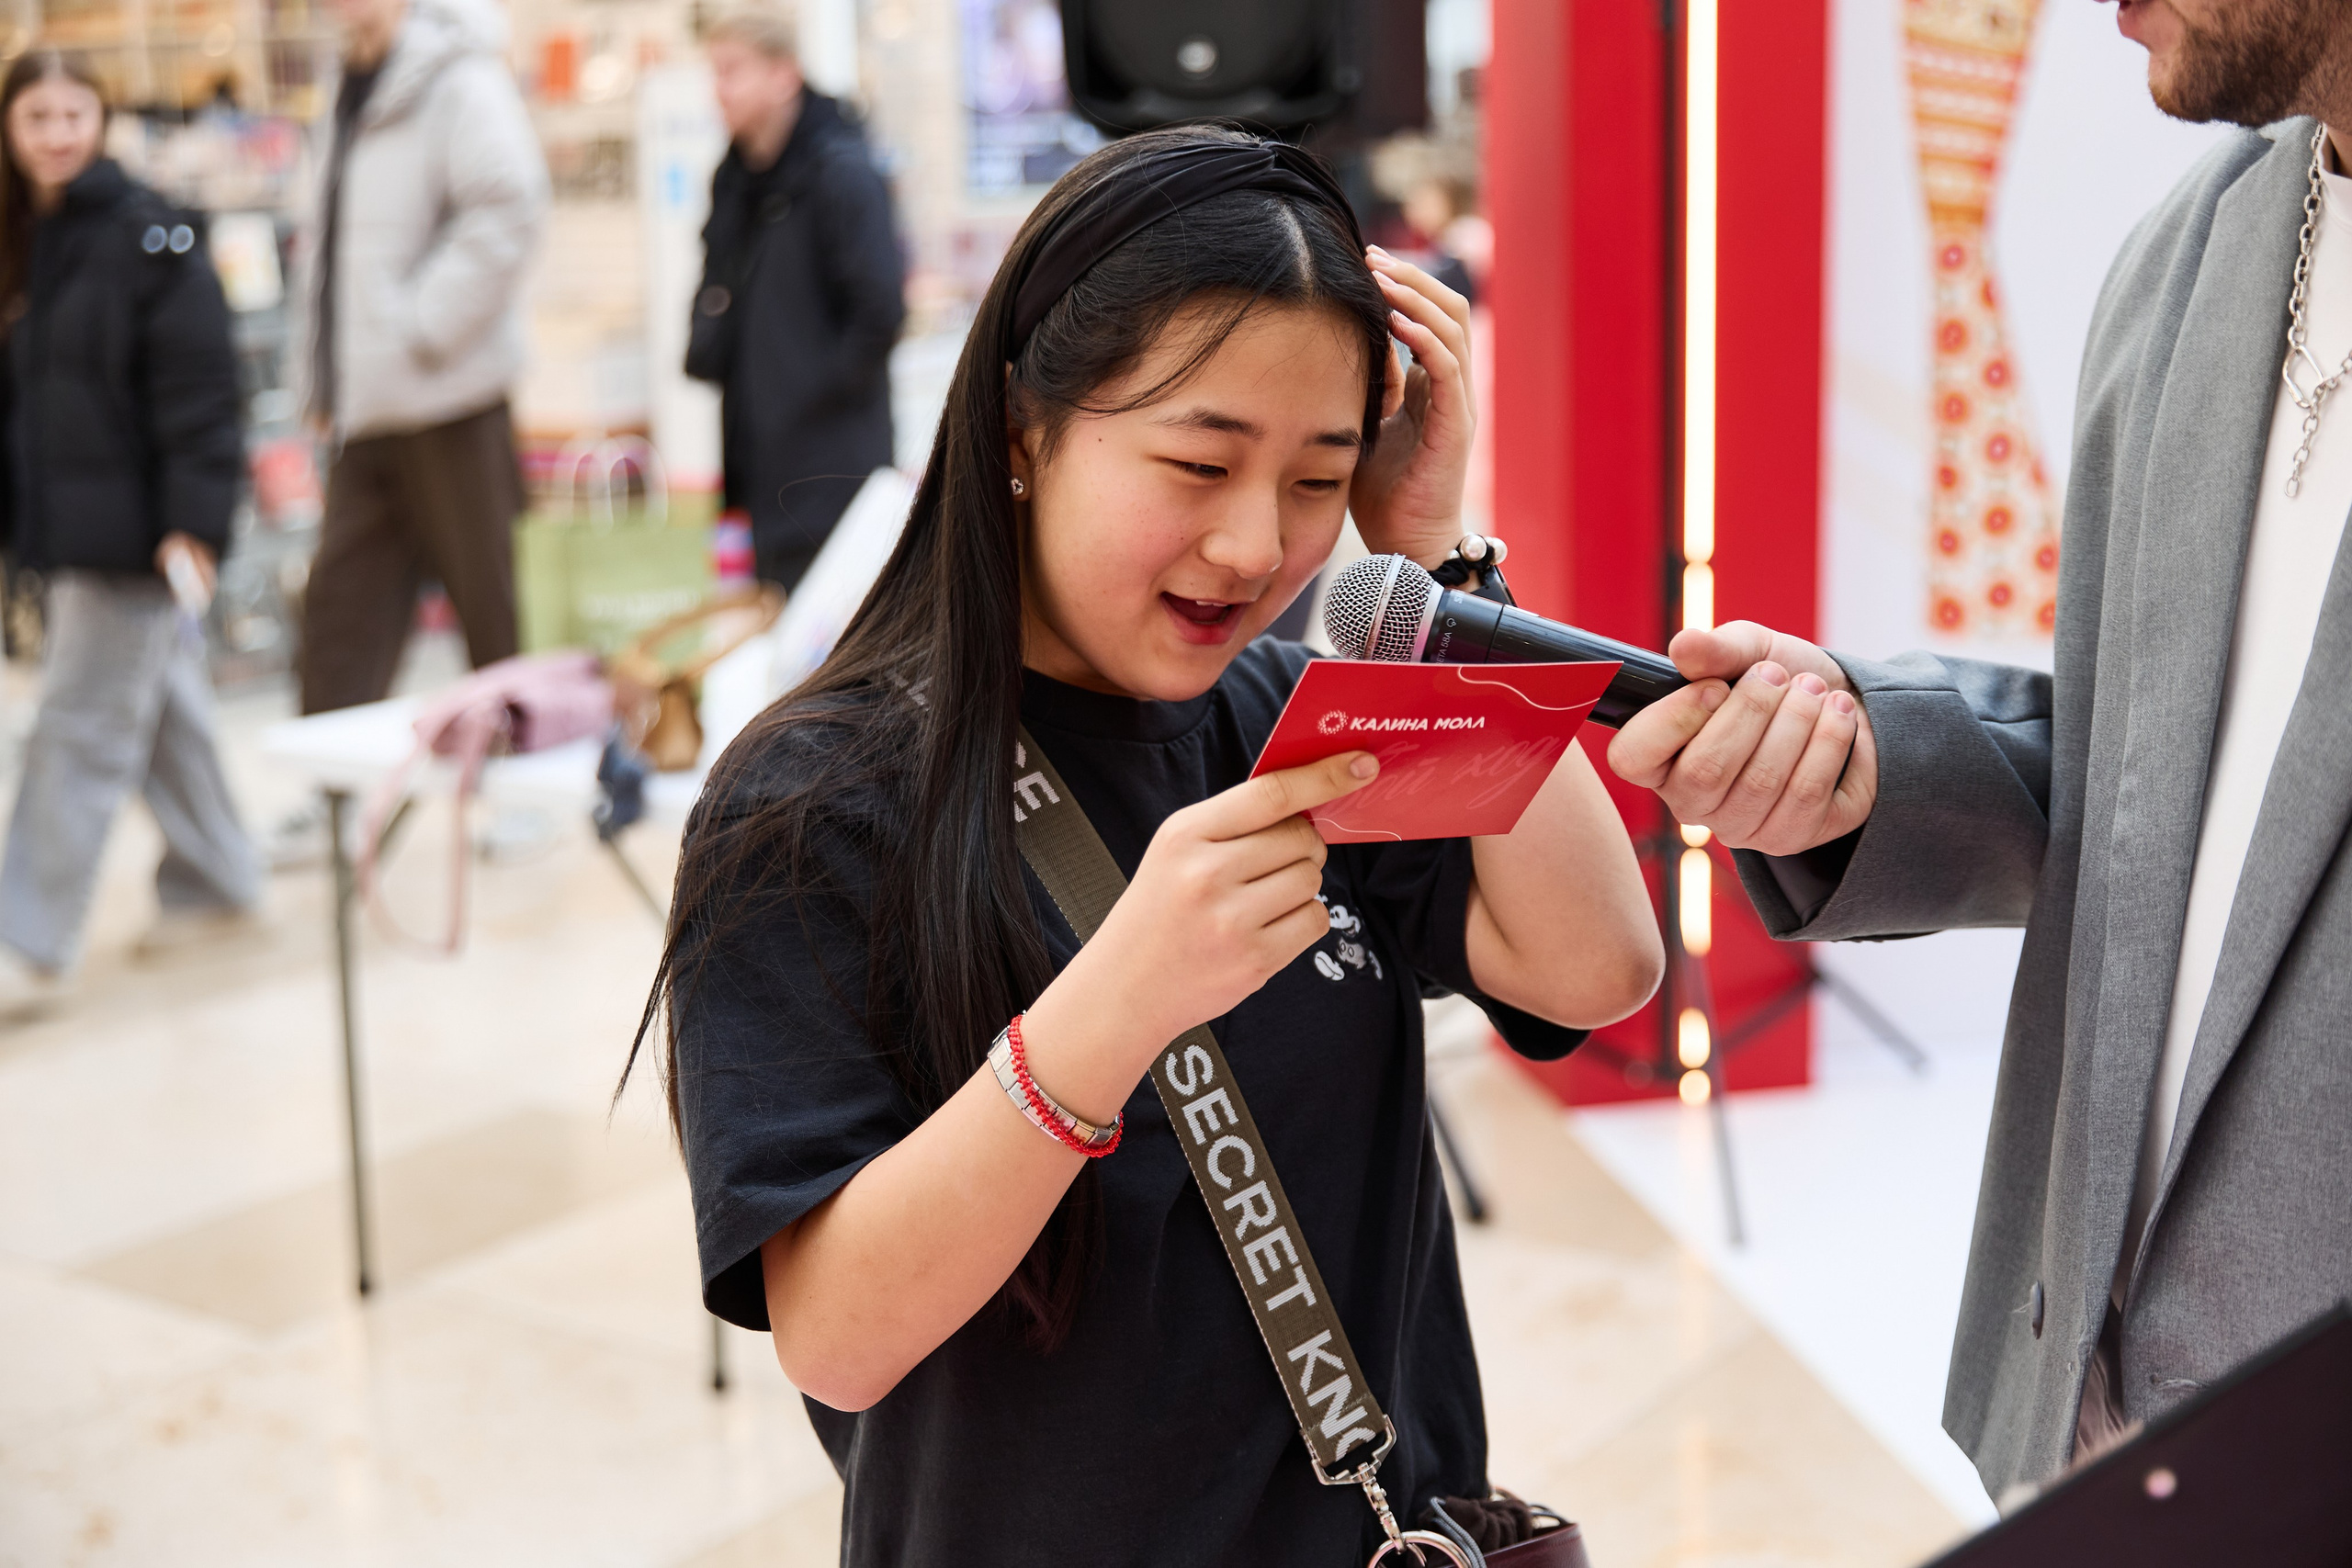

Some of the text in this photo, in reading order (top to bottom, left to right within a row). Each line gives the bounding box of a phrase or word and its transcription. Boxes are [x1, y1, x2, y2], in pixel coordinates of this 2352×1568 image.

[1440, 631, 1453, 649] 58A
[1350, 716, 1486, 731] КАЛИНА МОЛЛ
[1165, 1043, 1317, 1312] SECRET
